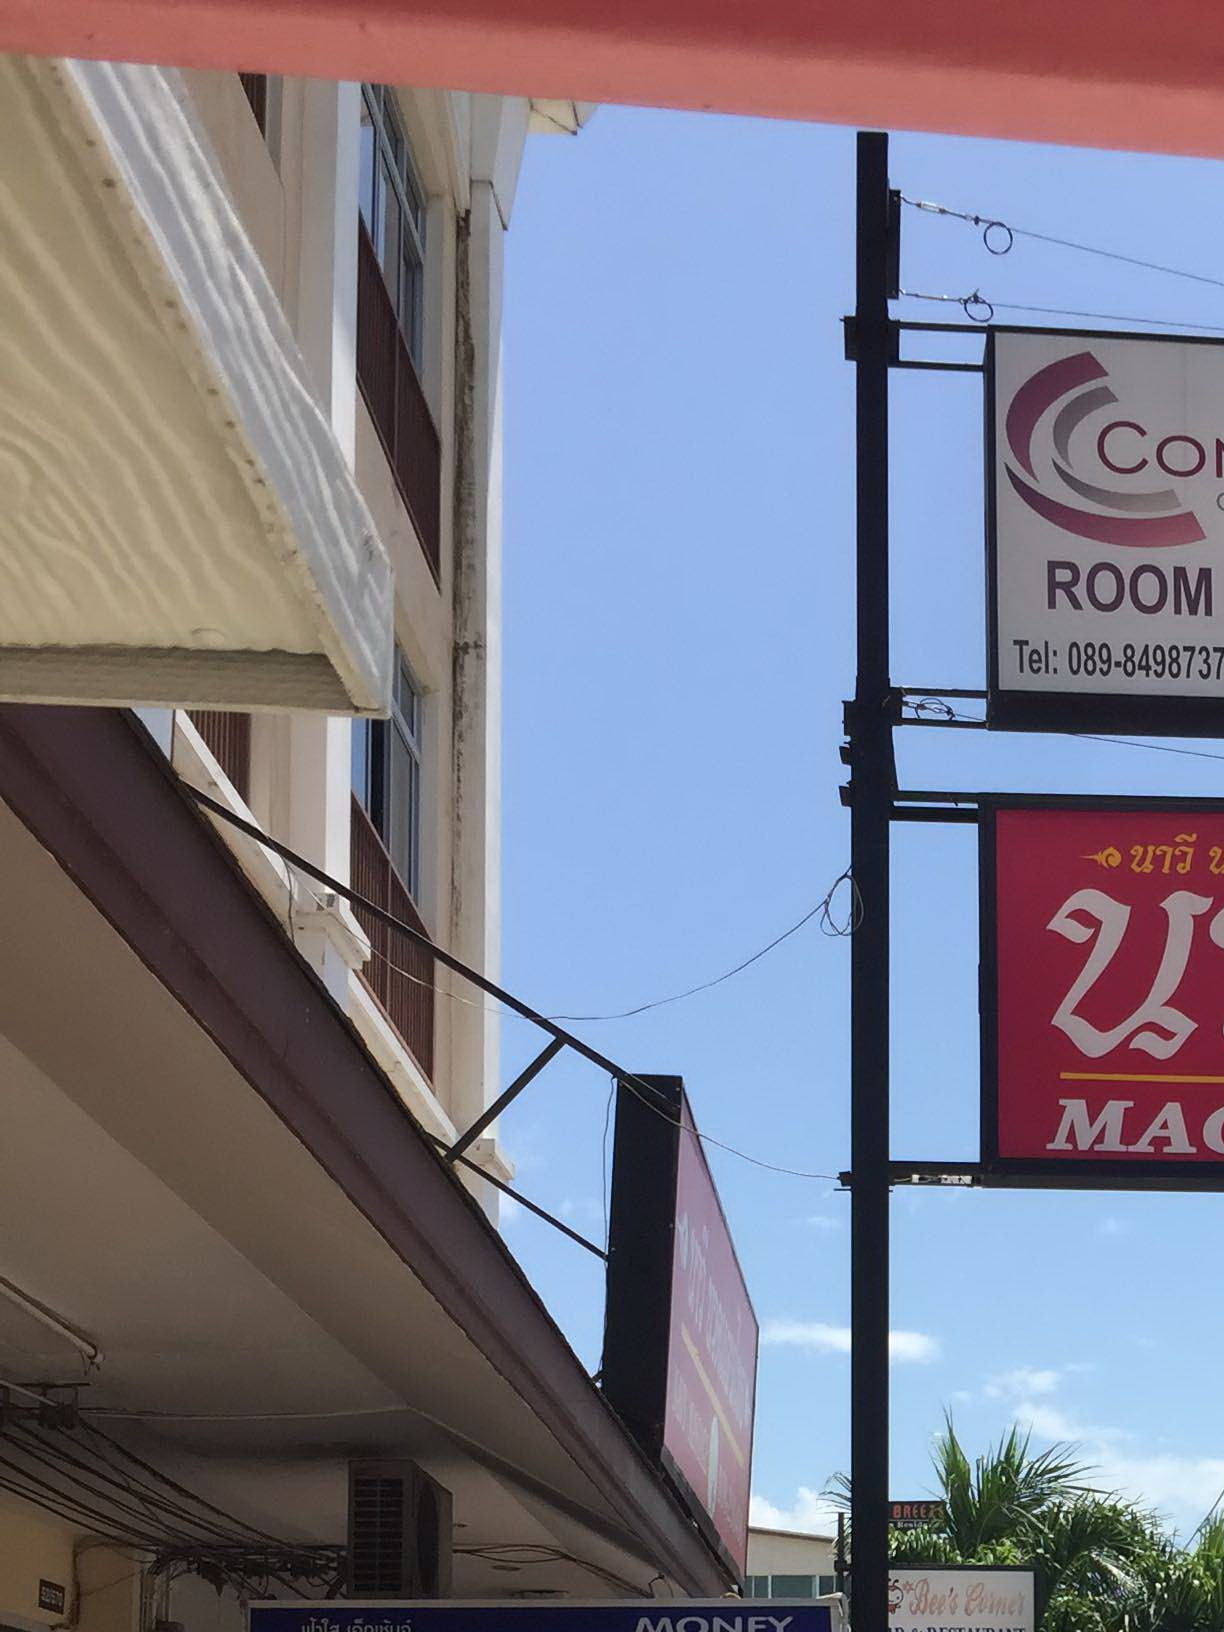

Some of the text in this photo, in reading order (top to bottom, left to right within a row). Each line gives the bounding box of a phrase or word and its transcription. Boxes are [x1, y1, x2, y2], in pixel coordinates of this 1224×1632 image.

[1047, 559, 1213, 618] ROOM
[1012, 639, 1058, 675] Tel:
[1130, 834, 1197, 874] นาวี
